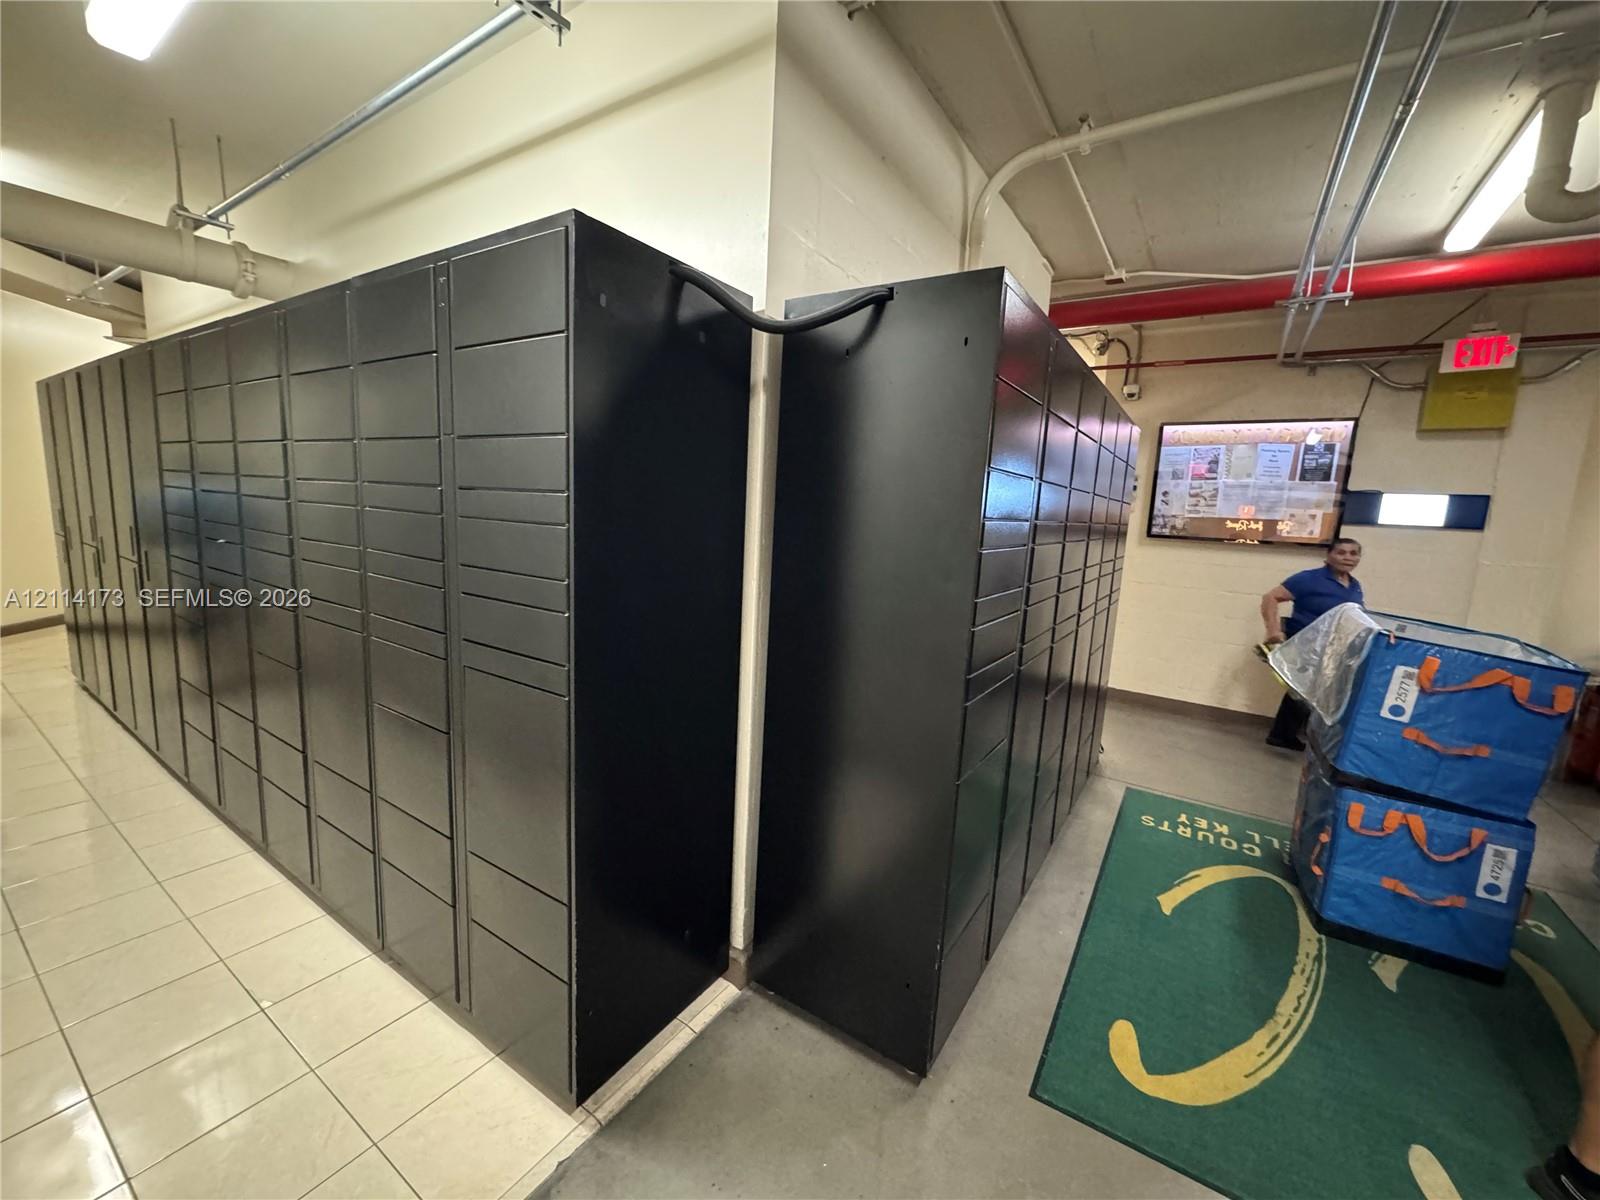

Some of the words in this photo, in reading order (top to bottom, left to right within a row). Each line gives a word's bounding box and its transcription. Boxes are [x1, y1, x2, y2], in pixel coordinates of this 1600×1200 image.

[1454, 336, 1509, 368] EXIT
[1395, 678, 1408, 704] 2577
[1140, 815, 1262, 857] COURTS
[1176, 813, 1230, 835] KEY
